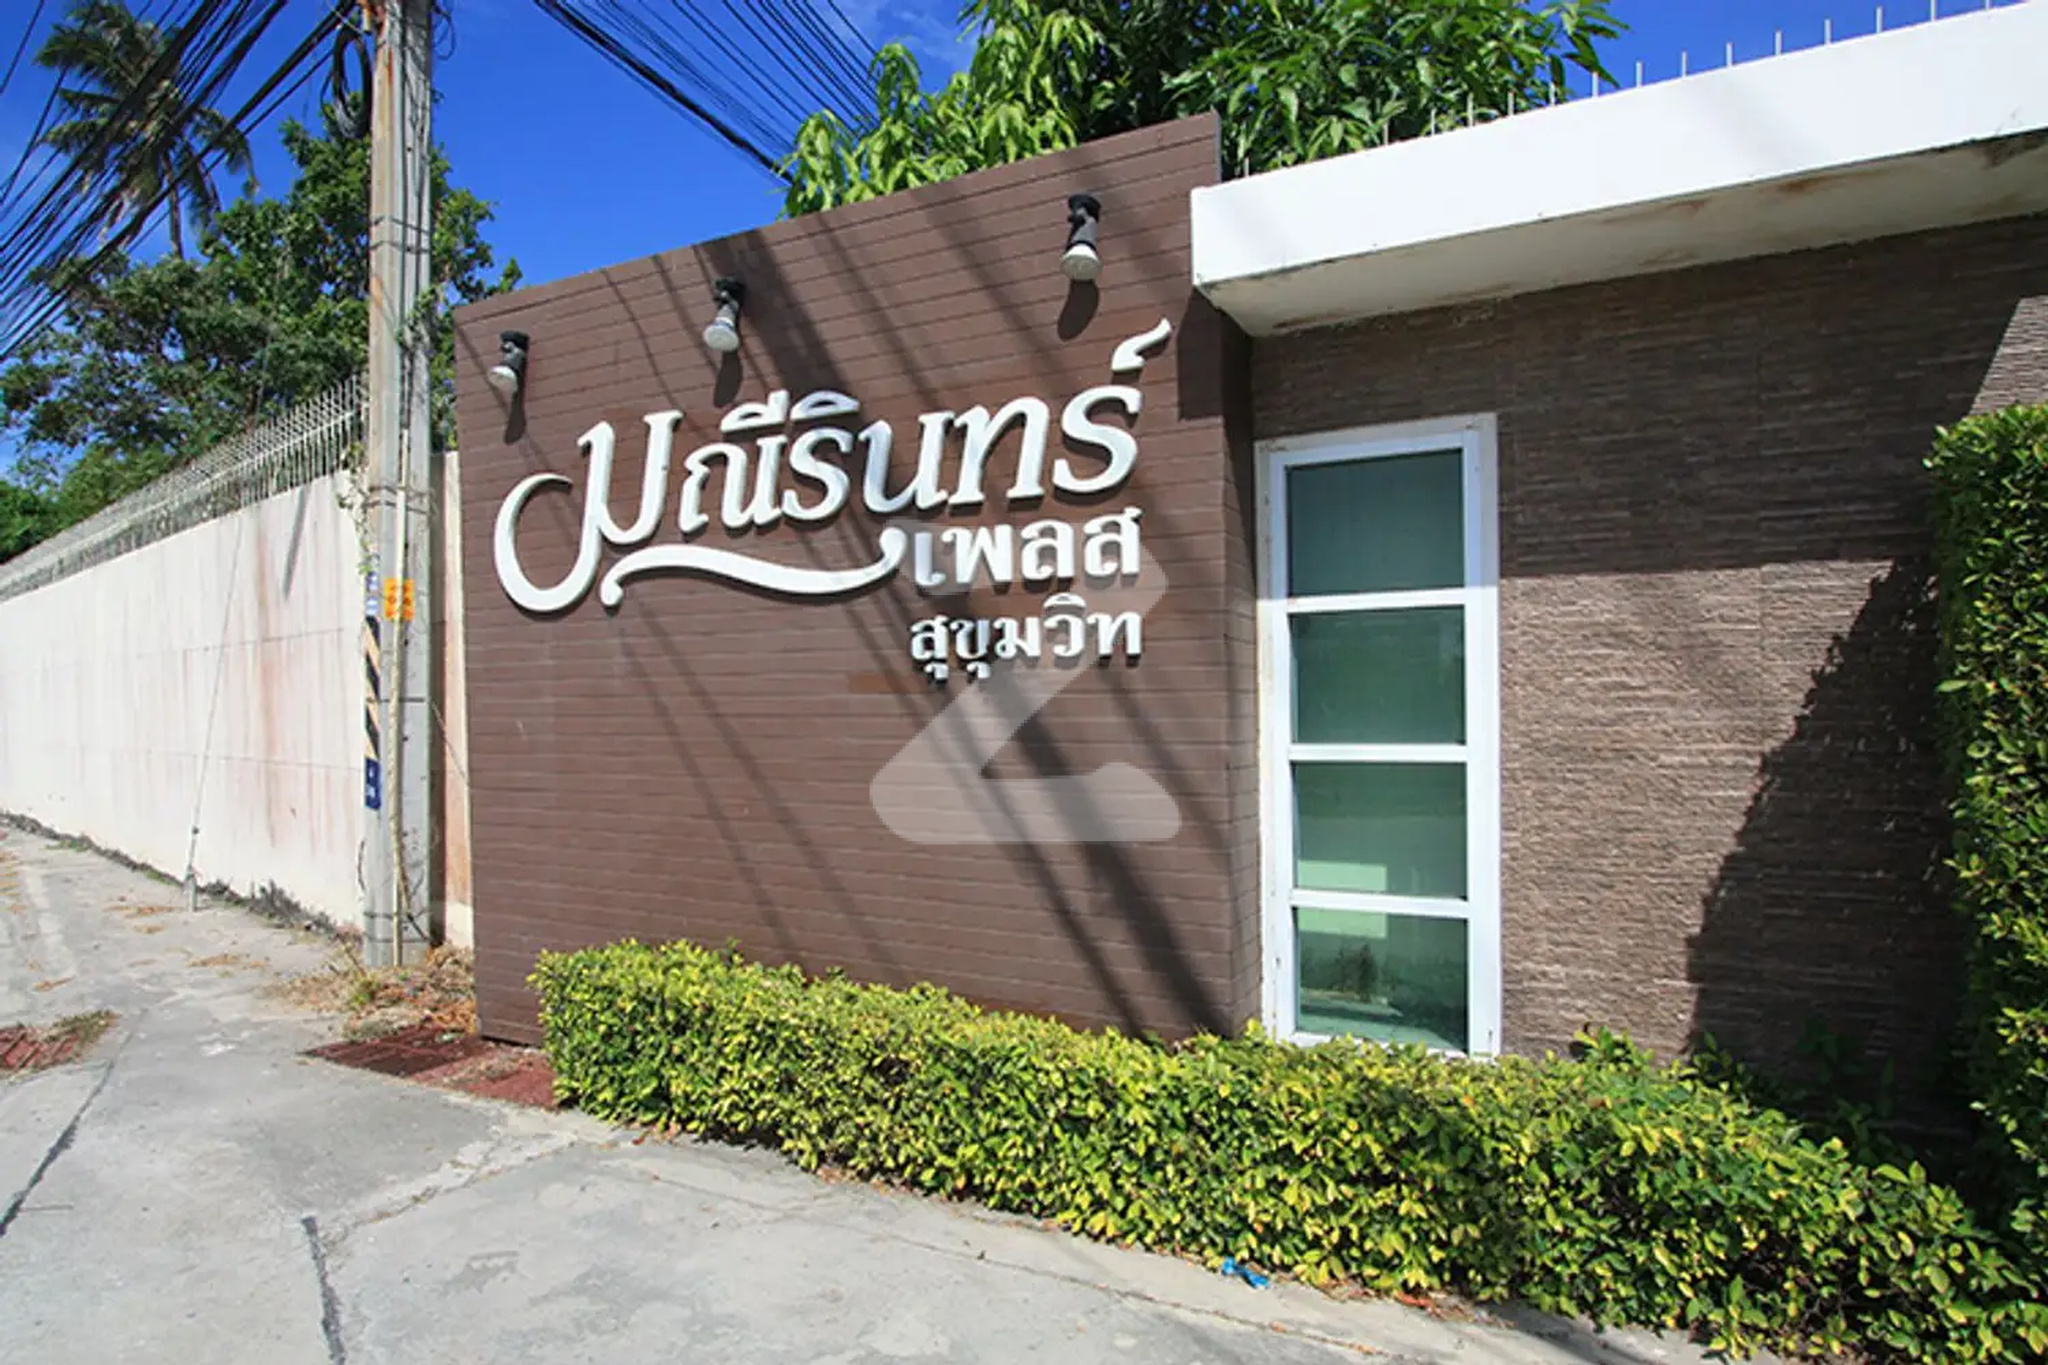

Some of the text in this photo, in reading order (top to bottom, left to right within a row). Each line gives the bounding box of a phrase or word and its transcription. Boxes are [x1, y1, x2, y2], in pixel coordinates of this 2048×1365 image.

[914, 507, 1142, 586] เพลส
[911, 592, 1142, 679] สุขุมวิท
